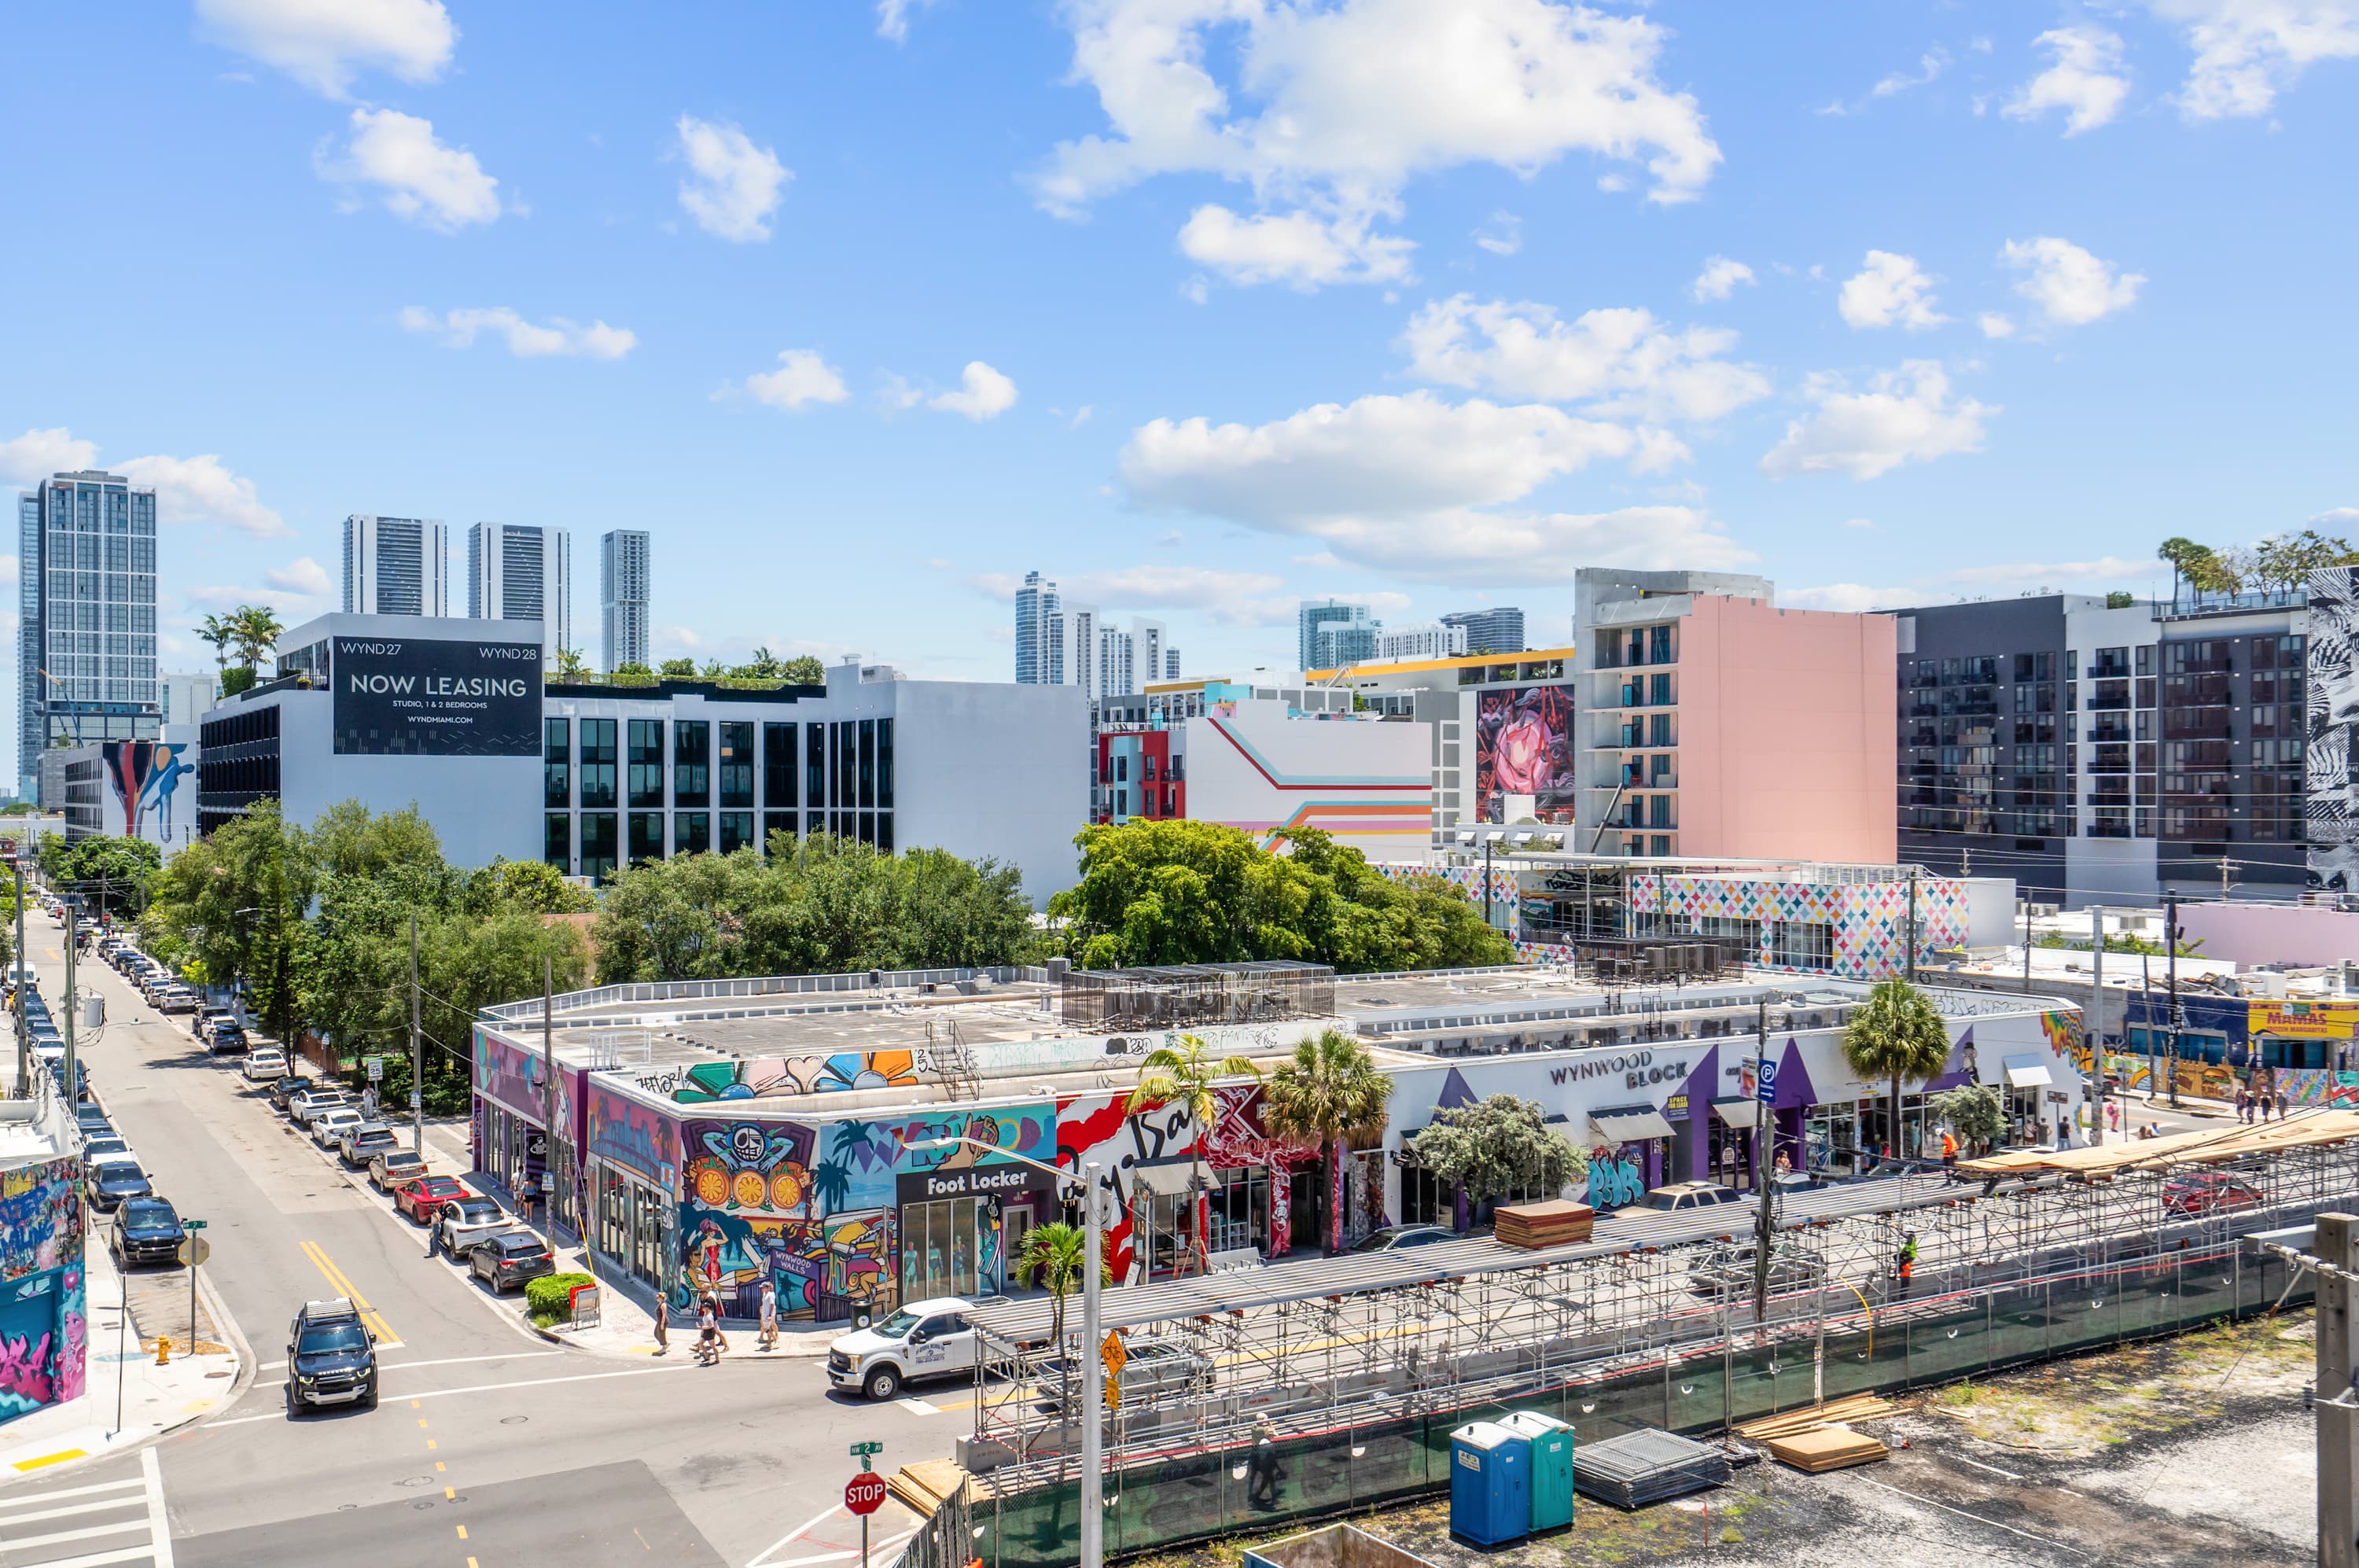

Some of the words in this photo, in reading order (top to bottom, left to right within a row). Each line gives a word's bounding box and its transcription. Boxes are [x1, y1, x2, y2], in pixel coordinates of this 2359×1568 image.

[351, 674, 416, 694] NOW
[425, 676, 527, 698] LEASING
[392, 700, 423, 709] STUDIO,
[445, 701, 488, 709] BEDROOMS
[407, 716, 473, 724] WYNDMIAMI.COM
[1550, 1050, 1653, 1086] WYNWOOD
[1625, 1062, 1688, 1090] BLOCK
[927, 1176, 966, 1195] Foot
[971, 1169, 1028, 1190] Locker
[775, 1251, 811, 1268] WYNWOOD
[780, 1261, 806, 1275] WALLS
[864, 1443, 870, 1454] 2
[848, 1483, 884, 1504] STOP
